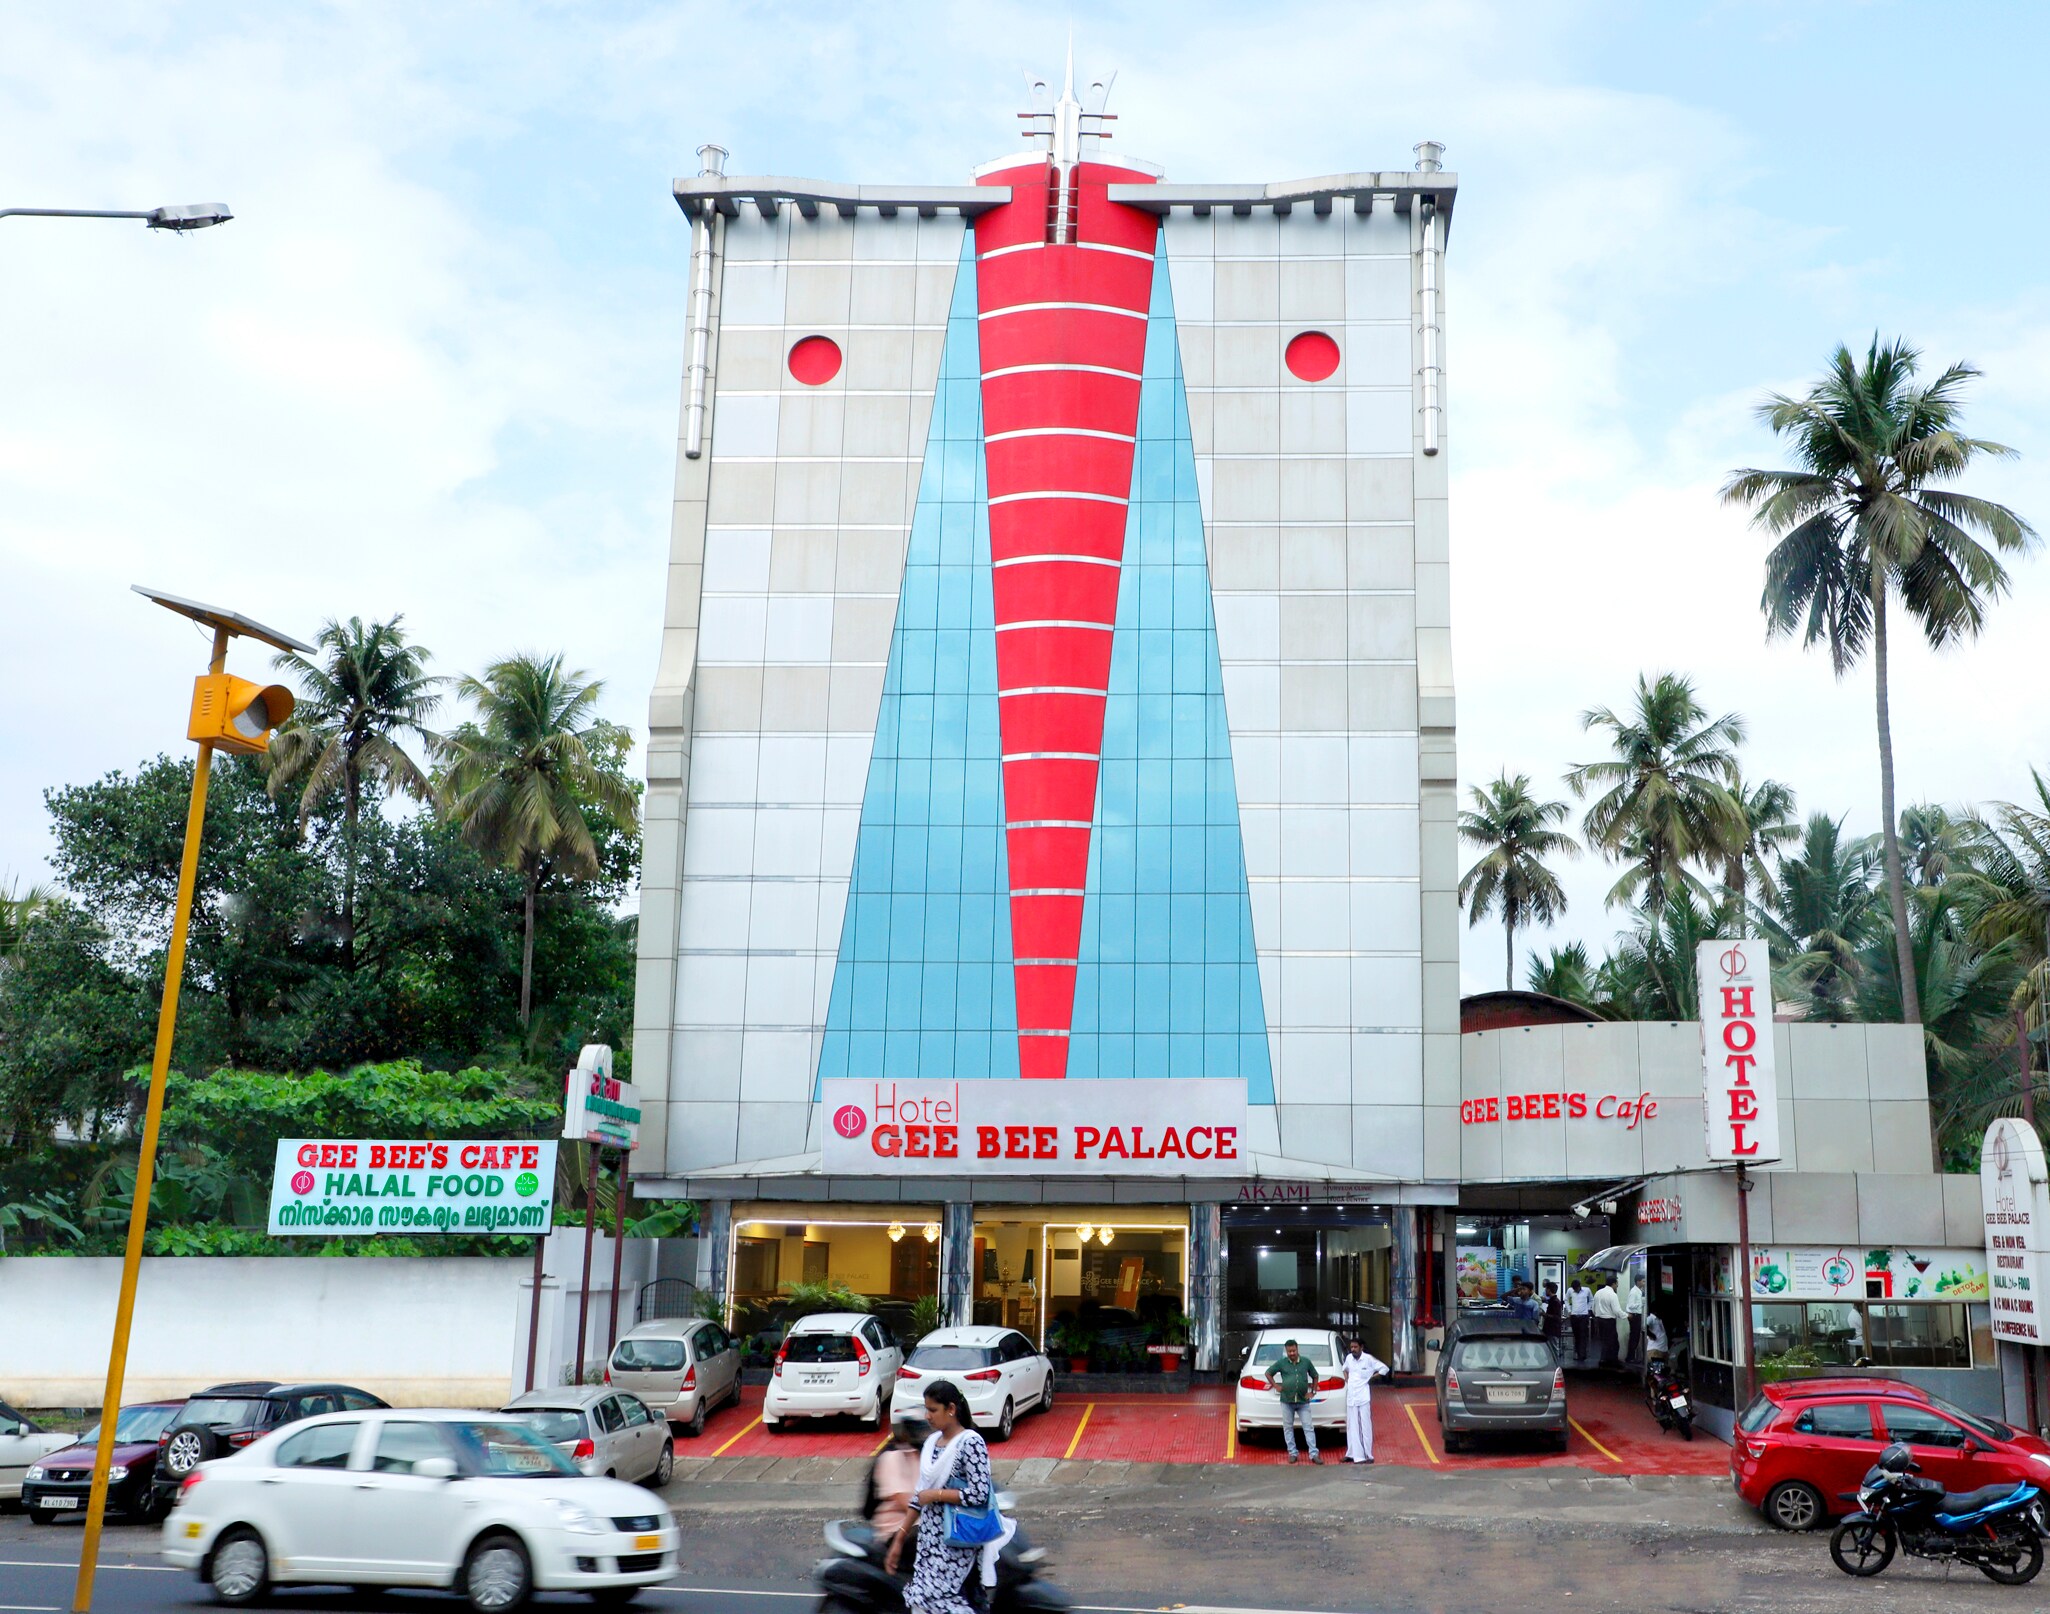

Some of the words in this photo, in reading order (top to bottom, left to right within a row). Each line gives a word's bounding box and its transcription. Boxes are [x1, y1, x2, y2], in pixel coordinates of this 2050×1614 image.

[1720, 987, 1759, 1155] HOTEL
[875, 1082, 959, 1123] Hotel
[1460, 1097, 1500, 1125] GEE
[1506, 1092, 1588, 1120] BEE'S
[1595, 1091, 1658, 1130] Cafe
[871, 1124, 959, 1159] GEE
[976, 1126, 1058, 1159] BEE
[1074, 1126, 1238, 1159] PALACE
[297, 1144, 359, 1168] GEE
[368, 1142, 449, 1169] BEE'S
[460, 1145, 540, 1169] CAFE
[324, 1173, 417, 1197] HALAL
[426, 1175, 504, 1197] FOOD
[1994, 1185, 2016, 1211] Hotel
[1985, 1213, 1996, 1224] GEE
[1997, 1213, 2007, 1224] BEE
[2008, 1213, 2030, 1224] PALACE
[1997, 1255, 2024, 1269] RESTAURANT
[1952, 1282, 1975, 1296] DETOX
[1970, 1283, 1986, 1294] BAR
[2018, 1277, 2030, 1290] FOOD
[2001, 1321, 2027, 1337] CONFERENCE
[2028, 1324, 2038, 1338] HALL
